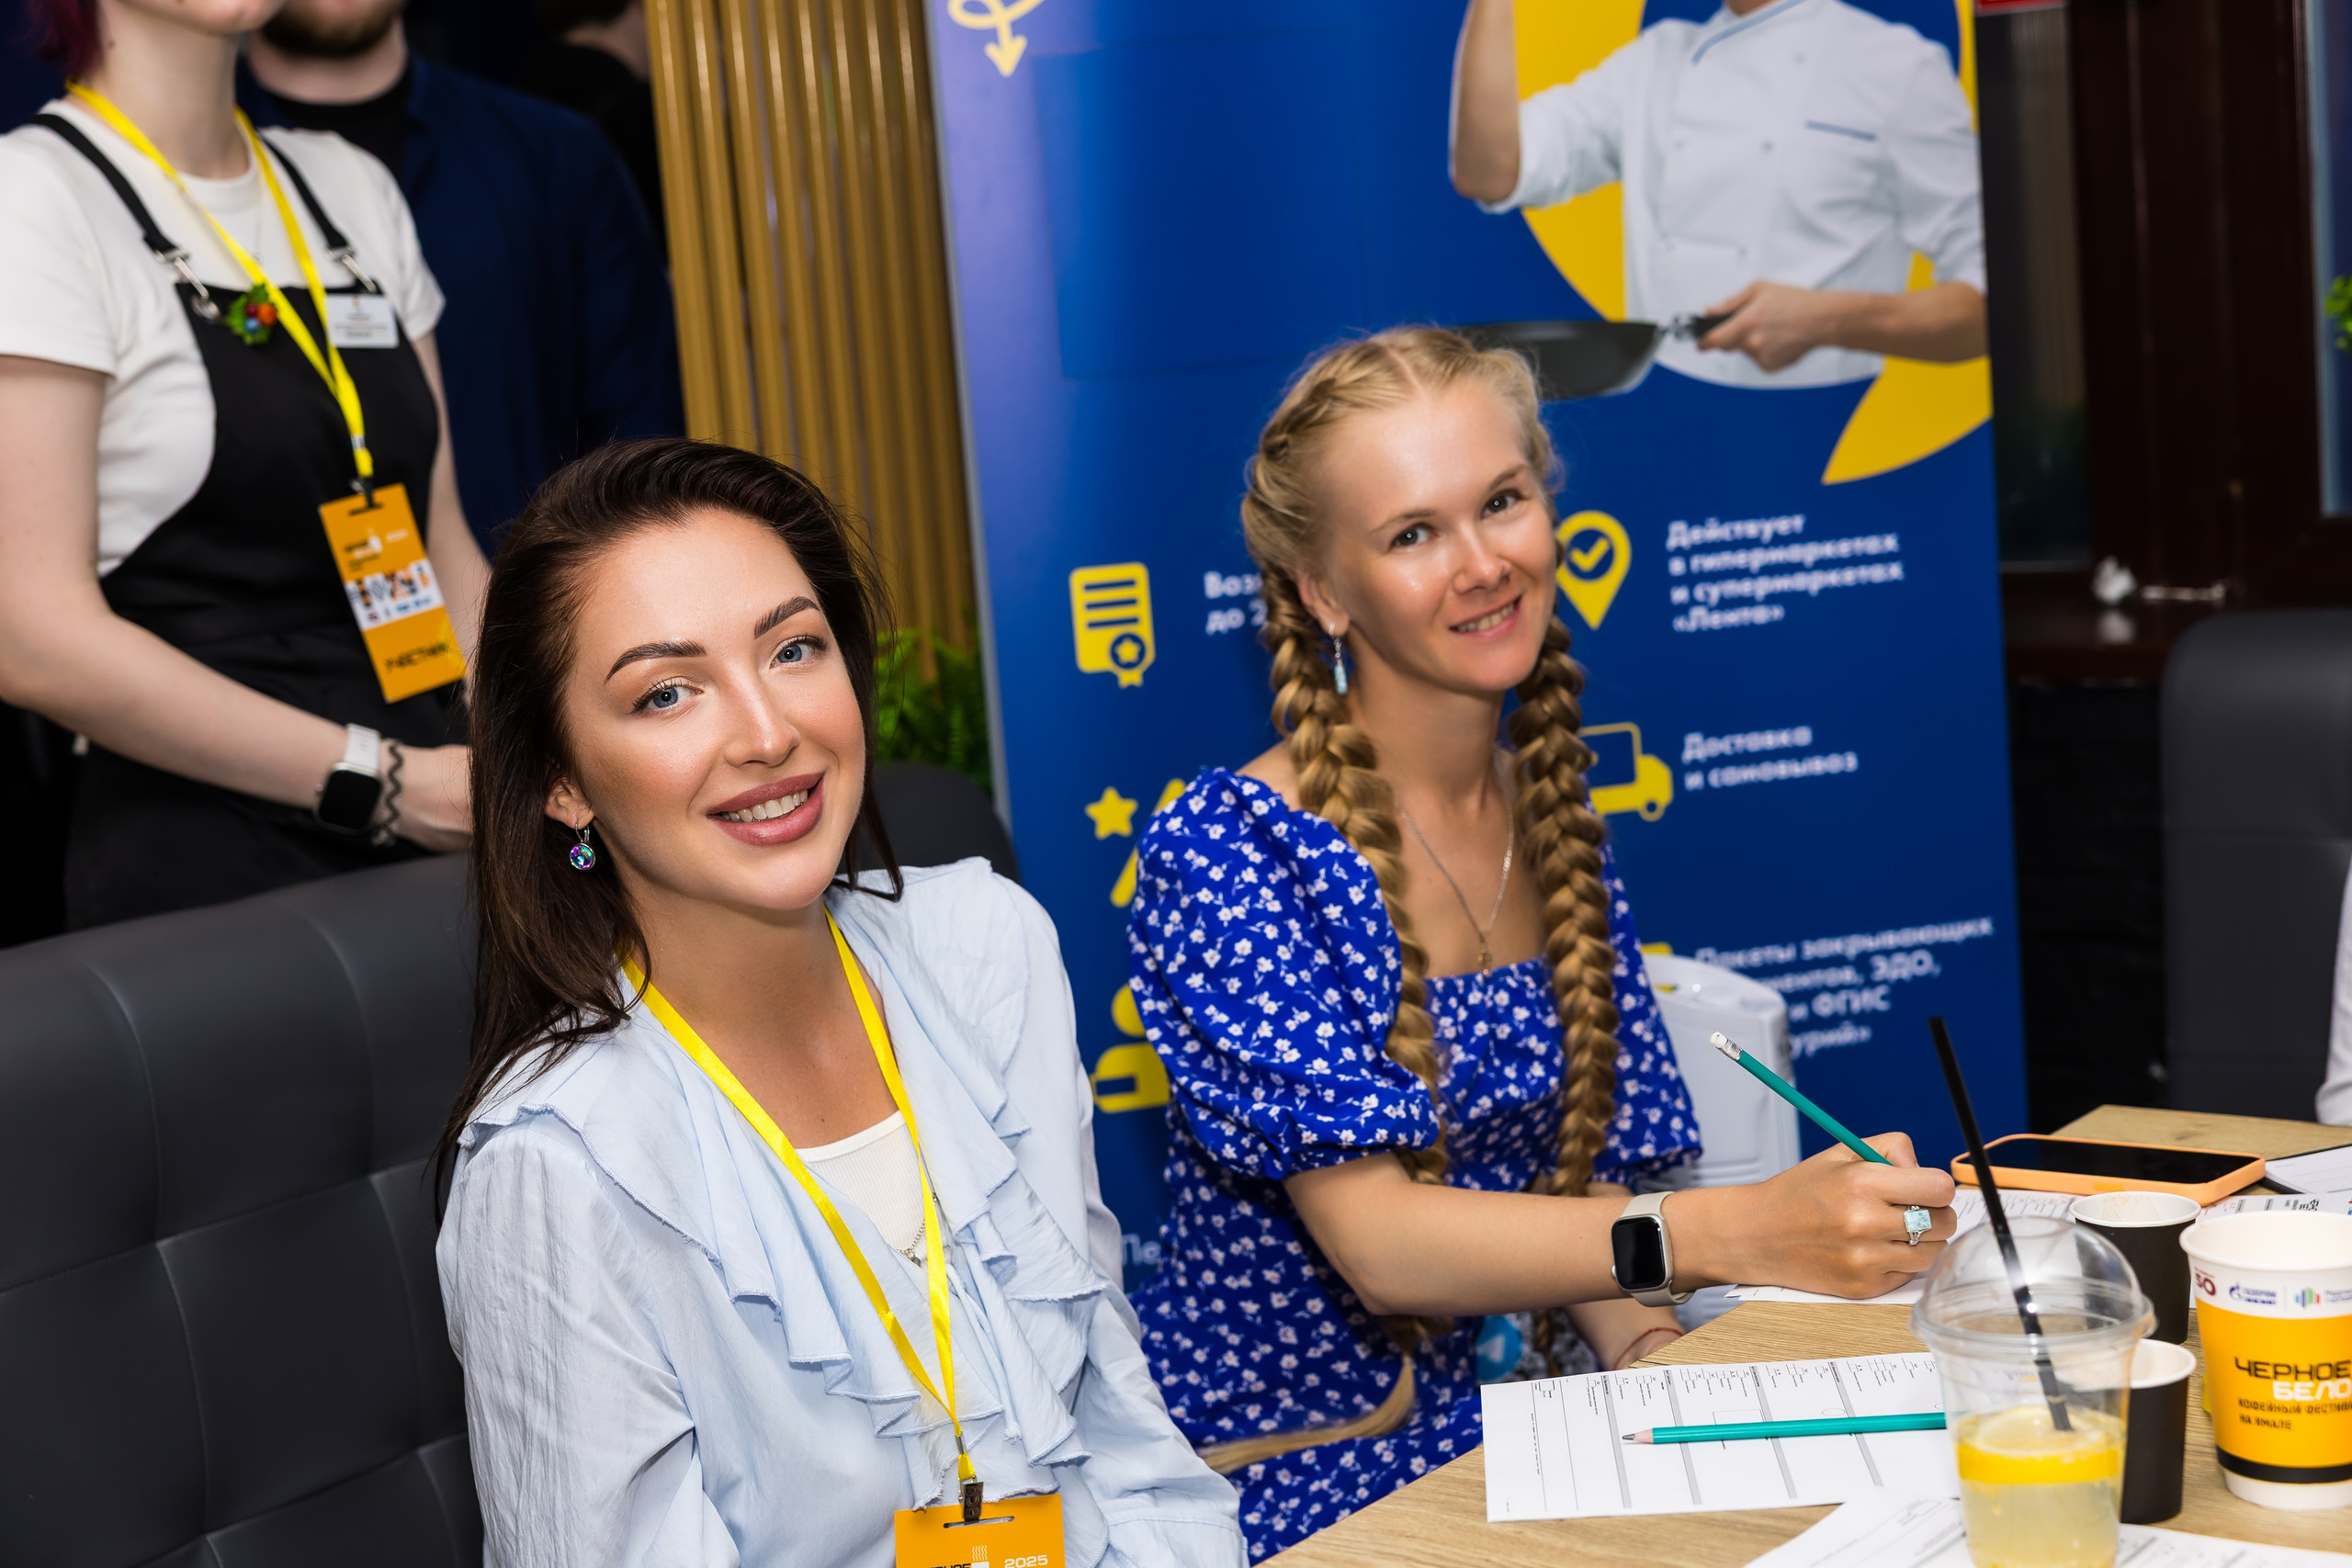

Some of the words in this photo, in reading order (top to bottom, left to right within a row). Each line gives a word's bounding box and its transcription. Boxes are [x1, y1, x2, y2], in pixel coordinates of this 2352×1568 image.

[1666, 514, 1805, 551] Действует
[1668, 556, 1687, 576] в
[1690, 533, 1900, 574] гипермаркетах
[1670, 585, 1690, 605] и
[1693, 561, 1905, 607] супермаркетах
[1205, 607, 1245, 636] до
[1672, 604, 1785, 632] «Лента»
[1681, 726, 1812, 764] Доставка
[1684, 771, 1703, 791] и
[1708, 751, 1858, 788] самовывоз
[1801, 917, 1993, 961] закрывающих
[1811, 985, 1892, 1018] ФГИС
[2234, 1357, 2351, 1381] ЧЕРНОЕ
[2238, 1397, 2301, 1414] КОФЕЙНЫЙ
[2239, 1414, 2252, 1425] НА
[2254, 1416, 2291, 1429] ЯМАЛЕ
[1004, 1554, 1048, 1568] 2025
